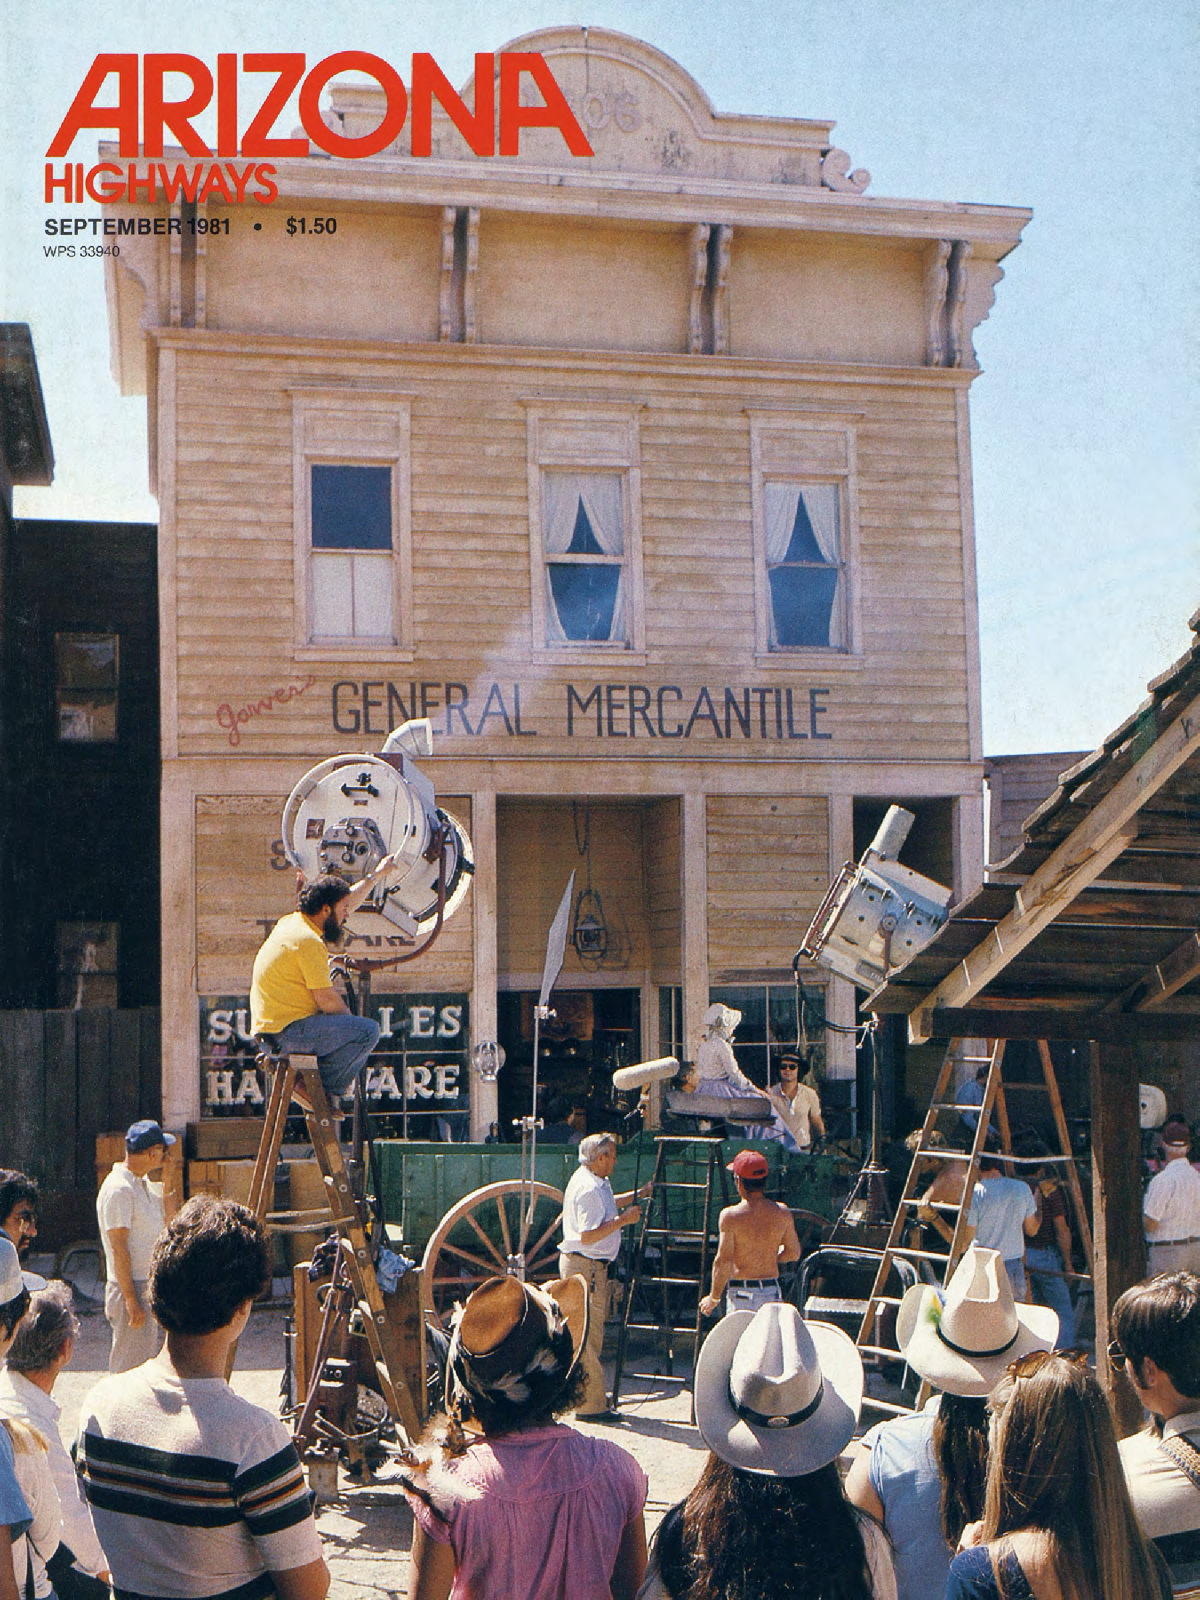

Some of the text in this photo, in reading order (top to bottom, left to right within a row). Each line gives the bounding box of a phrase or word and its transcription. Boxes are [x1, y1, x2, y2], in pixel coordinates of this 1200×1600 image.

[332, 680, 833, 740] GENERAL MERCANTILE
[207, 1005, 462, 1043] SUIES
[205, 1064, 460, 1105] HAARE
